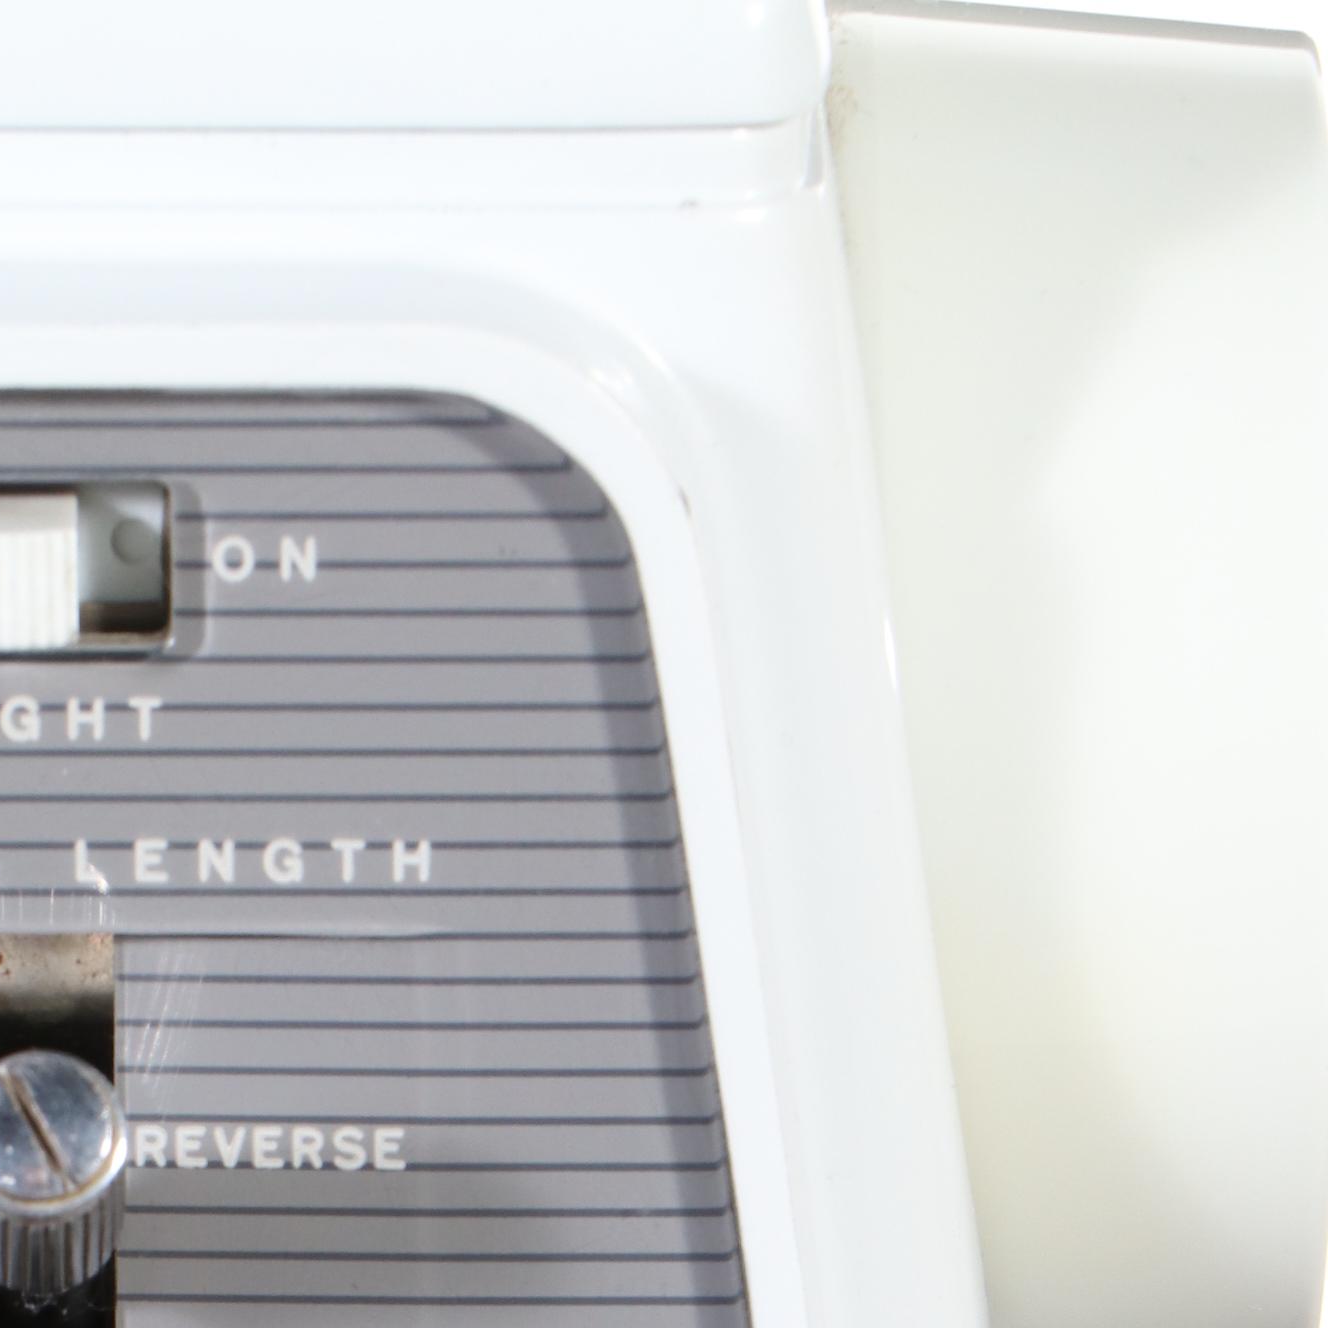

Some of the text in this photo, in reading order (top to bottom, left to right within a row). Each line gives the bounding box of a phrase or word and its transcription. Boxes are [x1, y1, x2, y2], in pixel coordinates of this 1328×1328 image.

[209, 535, 317, 583] ON
[74, 837, 431, 885] LENGTH
[134, 1124, 404, 1169] REVERSE
